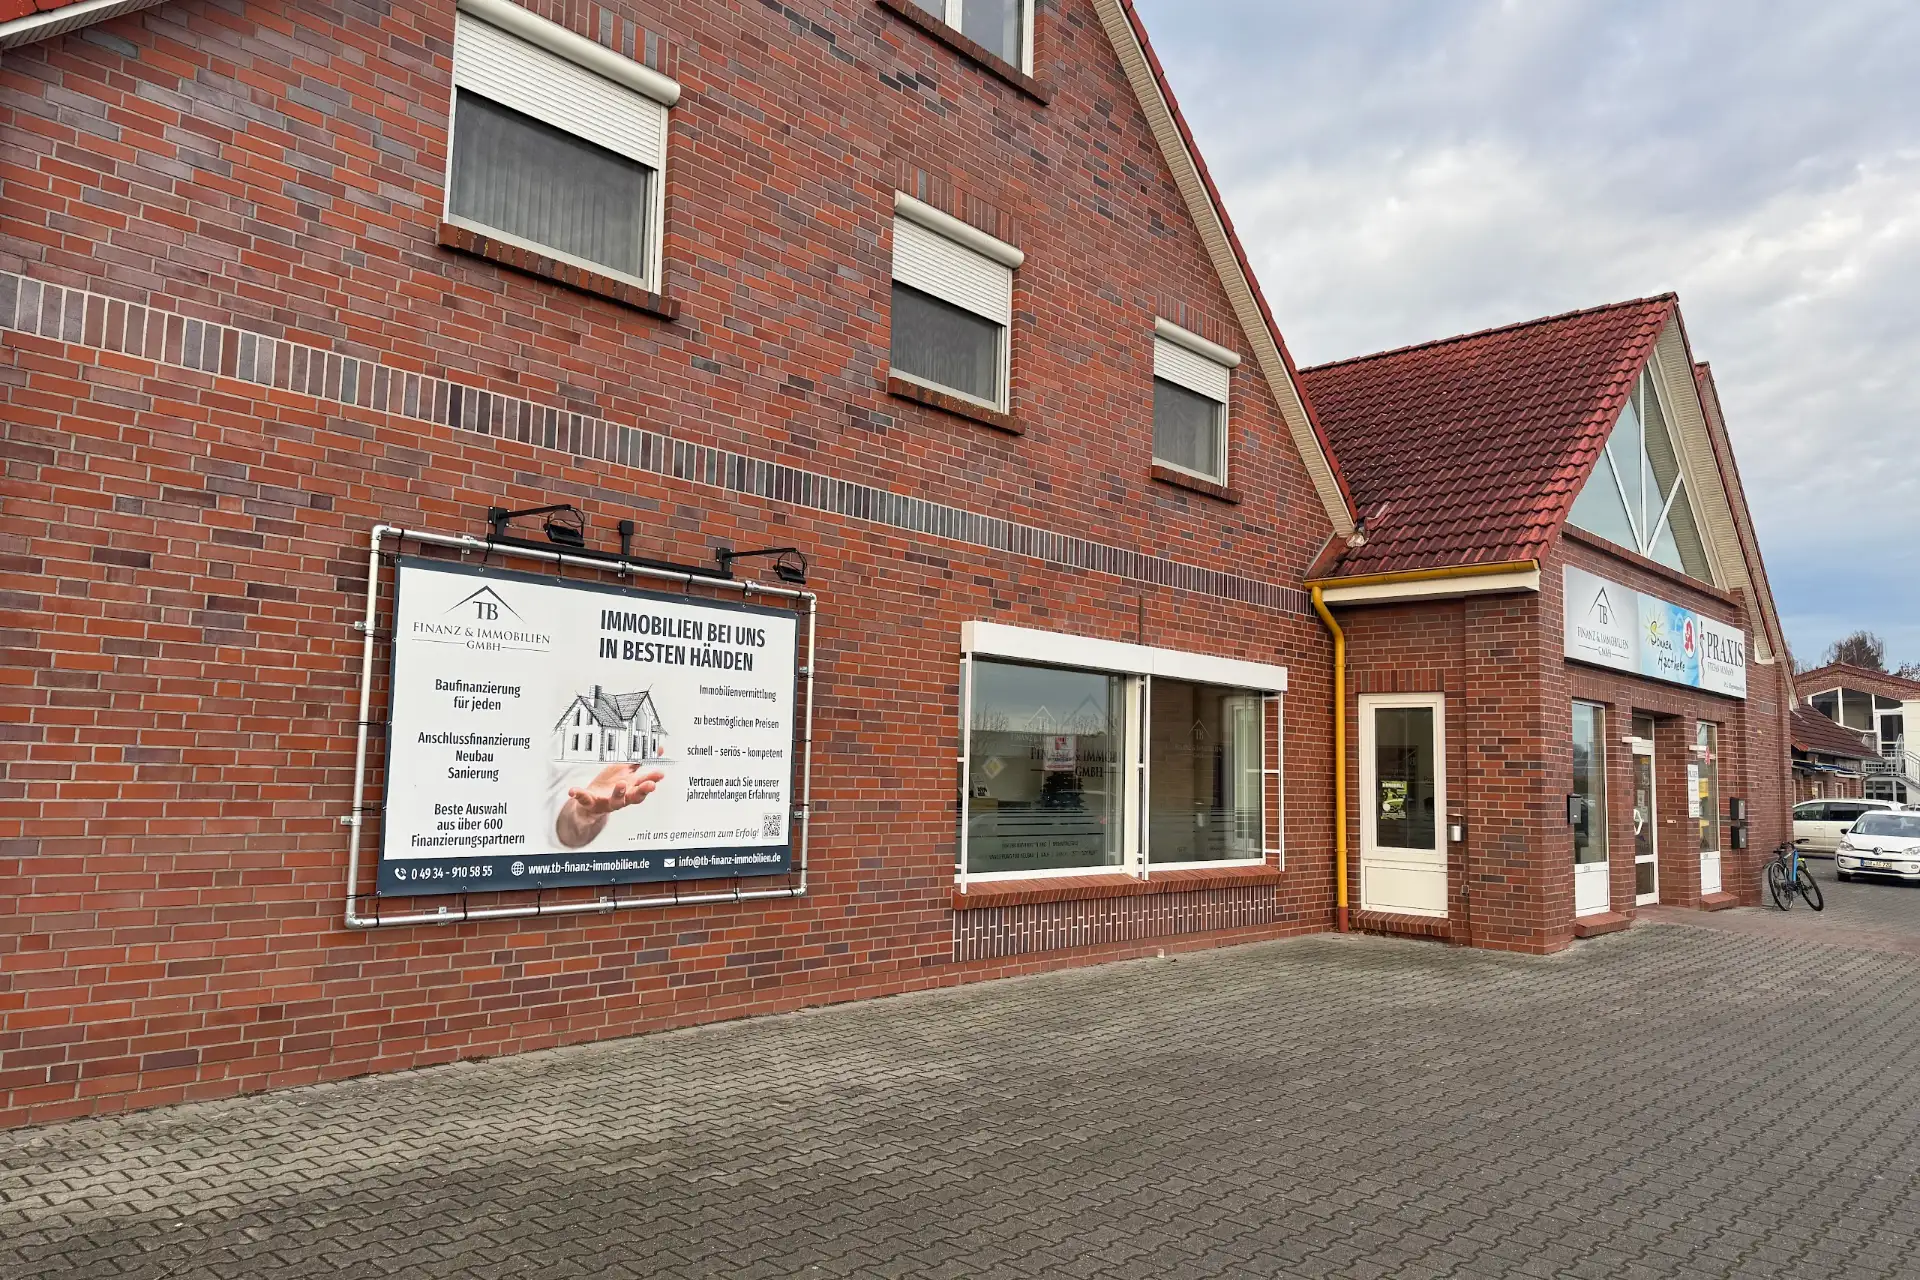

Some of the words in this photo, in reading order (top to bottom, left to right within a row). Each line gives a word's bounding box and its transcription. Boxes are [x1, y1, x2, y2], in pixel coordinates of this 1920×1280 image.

[472, 601, 499, 621] TB
[1597, 603, 1608, 625] TB
[413, 621, 461, 636] FINANZ
[464, 627, 474, 637] &
[477, 627, 551, 645] IMMOBILIEN
[600, 609, 703, 641] IMMOBILIEN
[707, 622, 732, 644] BEI
[735, 626, 766, 648] UNS
[466, 640, 501, 652] GMBH
[599, 637, 618, 659] IN
[622, 640, 686, 666] BESTEN
[689, 642, 753, 671] HÄNDEN
[1706, 631, 1744, 667] PRAXIS
[1657, 651, 1686, 674] Apotheke
[435, 678, 521, 699] Baufinanzierung
[699, 684, 777, 702] Immobilienvermittlung
[453, 695, 470, 709] für
[471, 697, 502, 712] jeden
[693, 715, 702, 725] zu
[703, 714, 754, 729] bestmöglichen
[755, 718, 780, 729] Preisen
[418, 731, 531, 749] Anschlussfinanzierung
[455, 750, 494, 763] Neubau
[687, 745, 713, 756] schnell
[719, 745, 741, 757] seriös
[747, 746, 783, 760] kompetent
[447, 766, 500, 782] Sanierung
[688, 776, 724, 787] Vertrauen
[724, 776, 741, 788] auch
[742, 776, 753, 787] Sie
[754, 778, 780, 788] unserer
[686, 789, 747, 802] jahrzehntelangen
[748, 789, 780, 802] Erfahrung
[434, 803, 464, 816] Beste
[465, 802, 508, 815] Auswahl
[436, 820, 456, 831] aus
[457, 818, 482, 831] über
[484, 818, 503, 830] 600
[411, 833, 525, 849] Finanzierungspartnern
[653, 830, 668, 840] uns
[670, 829, 716, 843] gemeinsam
[717, 829, 734, 838] zum
[528, 857, 650, 875] www.tb-finanz-immobilien.de
[678, 852, 781, 868] info@tb-finanz-immobilien.de
[411, 868, 417, 880] 0
[419, 868, 431, 880] 49
[432, 867, 444, 879] 34
[451, 866, 468, 879] 910
[469, 865, 481, 878] 58
[482, 865, 493, 877] 55
